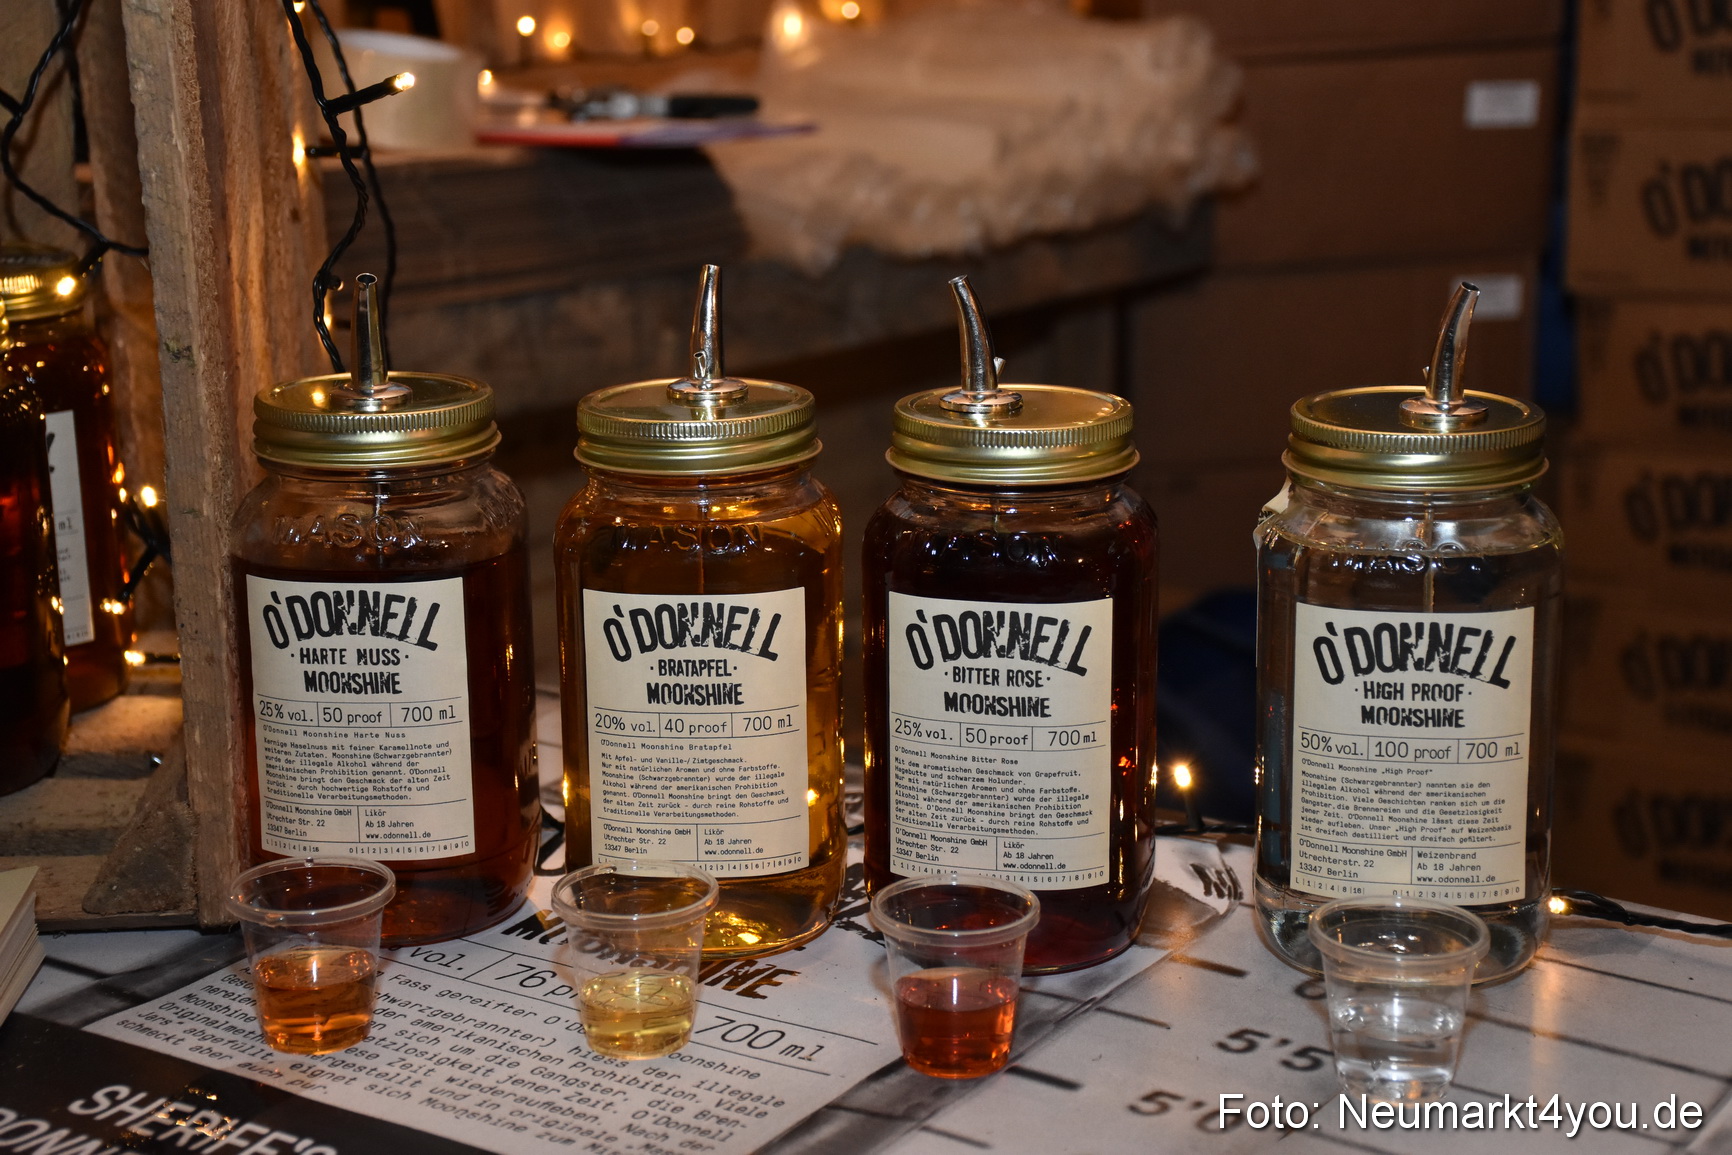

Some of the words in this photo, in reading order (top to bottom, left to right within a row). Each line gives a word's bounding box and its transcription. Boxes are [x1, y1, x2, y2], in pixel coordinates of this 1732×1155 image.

[263, 590, 440, 651] O'DONNELL
[603, 602, 781, 662] O'DONNELL
[906, 609, 1092, 676] O'DONNELL
[300, 648, 347, 664] HARTE
[357, 649, 400, 665] NUSS
[1313, 622, 1516, 689] O'DONNELL
[659, 659, 731, 677] BRATAPFEL
[953, 666, 999, 686] BITTER
[1007, 670, 1043, 688] ROSE
[304, 671, 402, 694] MOONSHINE
[1363, 681, 1404, 700] HIGH
[1412, 683, 1464, 702] PROOF
[647, 683, 744, 705] MOONSHINE
[260, 700, 283, 718] 25%
[288, 710, 313, 721] vol.
[323, 707, 342, 722] 50
[348, 711, 382, 724] proof
[401, 706, 432, 722] 700
[440, 705, 455, 719] ml
[944, 692, 1051, 718] MOONSHINE
[595, 713, 625, 730] 20%
[631, 721, 655, 732] vol.
[665, 719, 684, 733] 40
[689, 722, 727, 735] proof
[743, 716, 771, 731] 700
[778, 714, 792, 728] ml
[1361, 706, 1465, 728] MOONSHINE
[263, 724, 297, 736] O'Donnell
[303, 730, 348, 738] Moonshine
[895, 718, 922, 737] 25%
[926, 729, 952, 740] vol.
[966, 729, 987, 744] 50
[990, 733, 1028, 746] proof
[1048, 730, 1080, 746] 700
[1083, 732, 1096, 743] ml
[601, 739, 635, 749] O'Donnell
[641, 743, 684, 751] Moonshine
[1301, 732, 1332, 752] 50%
[1335, 742, 1363, 756] vol.
[1375, 741, 1408, 757] 100
[1414, 746, 1451, 761] proof
[1466, 742, 1497, 759] 700
[1505, 742, 1520, 756] ml
[895, 746, 926, 758] O'Donnell
[931, 752, 967, 761] Moonshine
[972, 756, 997, 764] Bitter
[1001, 757, 1018, 765] Rose
[739, 764, 780, 772] Farbstoffe.
[1302, 759, 1334, 770] O'Donnell
[1339, 765, 1377, 774] Moonshine
[1302, 771, 1342, 782] Moonshine
[1342, 777, 1421, 788] (Schwarzgebrannter)
[266, 801, 293, 812] O'Donnell
[295, 807, 332, 815] Moonshine
[365, 809, 386, 817] Likör
[266, 813, 296, 824] Utrechter
[298, 818, 313, 826] Str.
[267, 824, 282, 833] 13347
[285, 827, 307, 837] Berlin
[366, 831, 431, 839] www.odonnell.de
[604, 824, 632, 834] O'Donnell
[636, 827, 671, 835] Moonshine
[896, 828, 927, 840] O'Donnell
[930, 835, 967, 845] Moonshine
[604, 834, 635, 844] Utrechter
[639, 837, 654, 845] Str.
[896, 837, 927, 850] Utrechter
[931, 844, 947, 853] Str.
[1299, 839, 1339, 853] O'Donnell
[1342, 846, 1384, 856] Moonshine
[605, 844, 621, 852] 13347
[625, 846, 647, 854] Berlin
[705, 847, 763, 856] www.odonnell.de
[896, 847, 912, 857] 13347
[916, 852, 939, 861] Berlin
[1418, 851, 1476, 859] Weizenbrand
[1003, 862, 1066, 870] www.odonnell.de
[1300, 850, 1360, 867] Utrechterstr.
[1364, 860, 1374, 868] 22
[1417, 863, 1427, 871] Ab
[1434, 863, 1443, 871] 18
[1300, 862, 1322, 874] 13347
[1327, 868, 1358, 878] Berlin
[1417, 875, 1495, 883] www.odonnell.de
[410, 947, 463, 970] vol.
[495, 964, 557, 988] 76
[389, 974, 431, 992] Fass
[438, 988, 537, 1023] gereifter
[116, 1018, 182, 1045] schmeckt
[188, 1044, 233, 1061] aber
[410, 1018, 565, 1066] amerikanischen
[695, 1015, 785, 1050] 700
[781, 1045, 824, 1062] ml
[395, 1028, 441, 1046] sich
[450, 1043, 476, 1056] um
[485, 1054, 521, 1070] die
[668, 1050, 762, 1080] oonshine
[568, 1046, 630, 1068] hiess
[642, 1065, 681, 1082] der
[693, 1079, 785, 1108] illegale
[647, 1099, 685, 1114] die
[715, 1099, 769, 1119] Viele
[631, 1110, 735, 1143] O'Donnell
